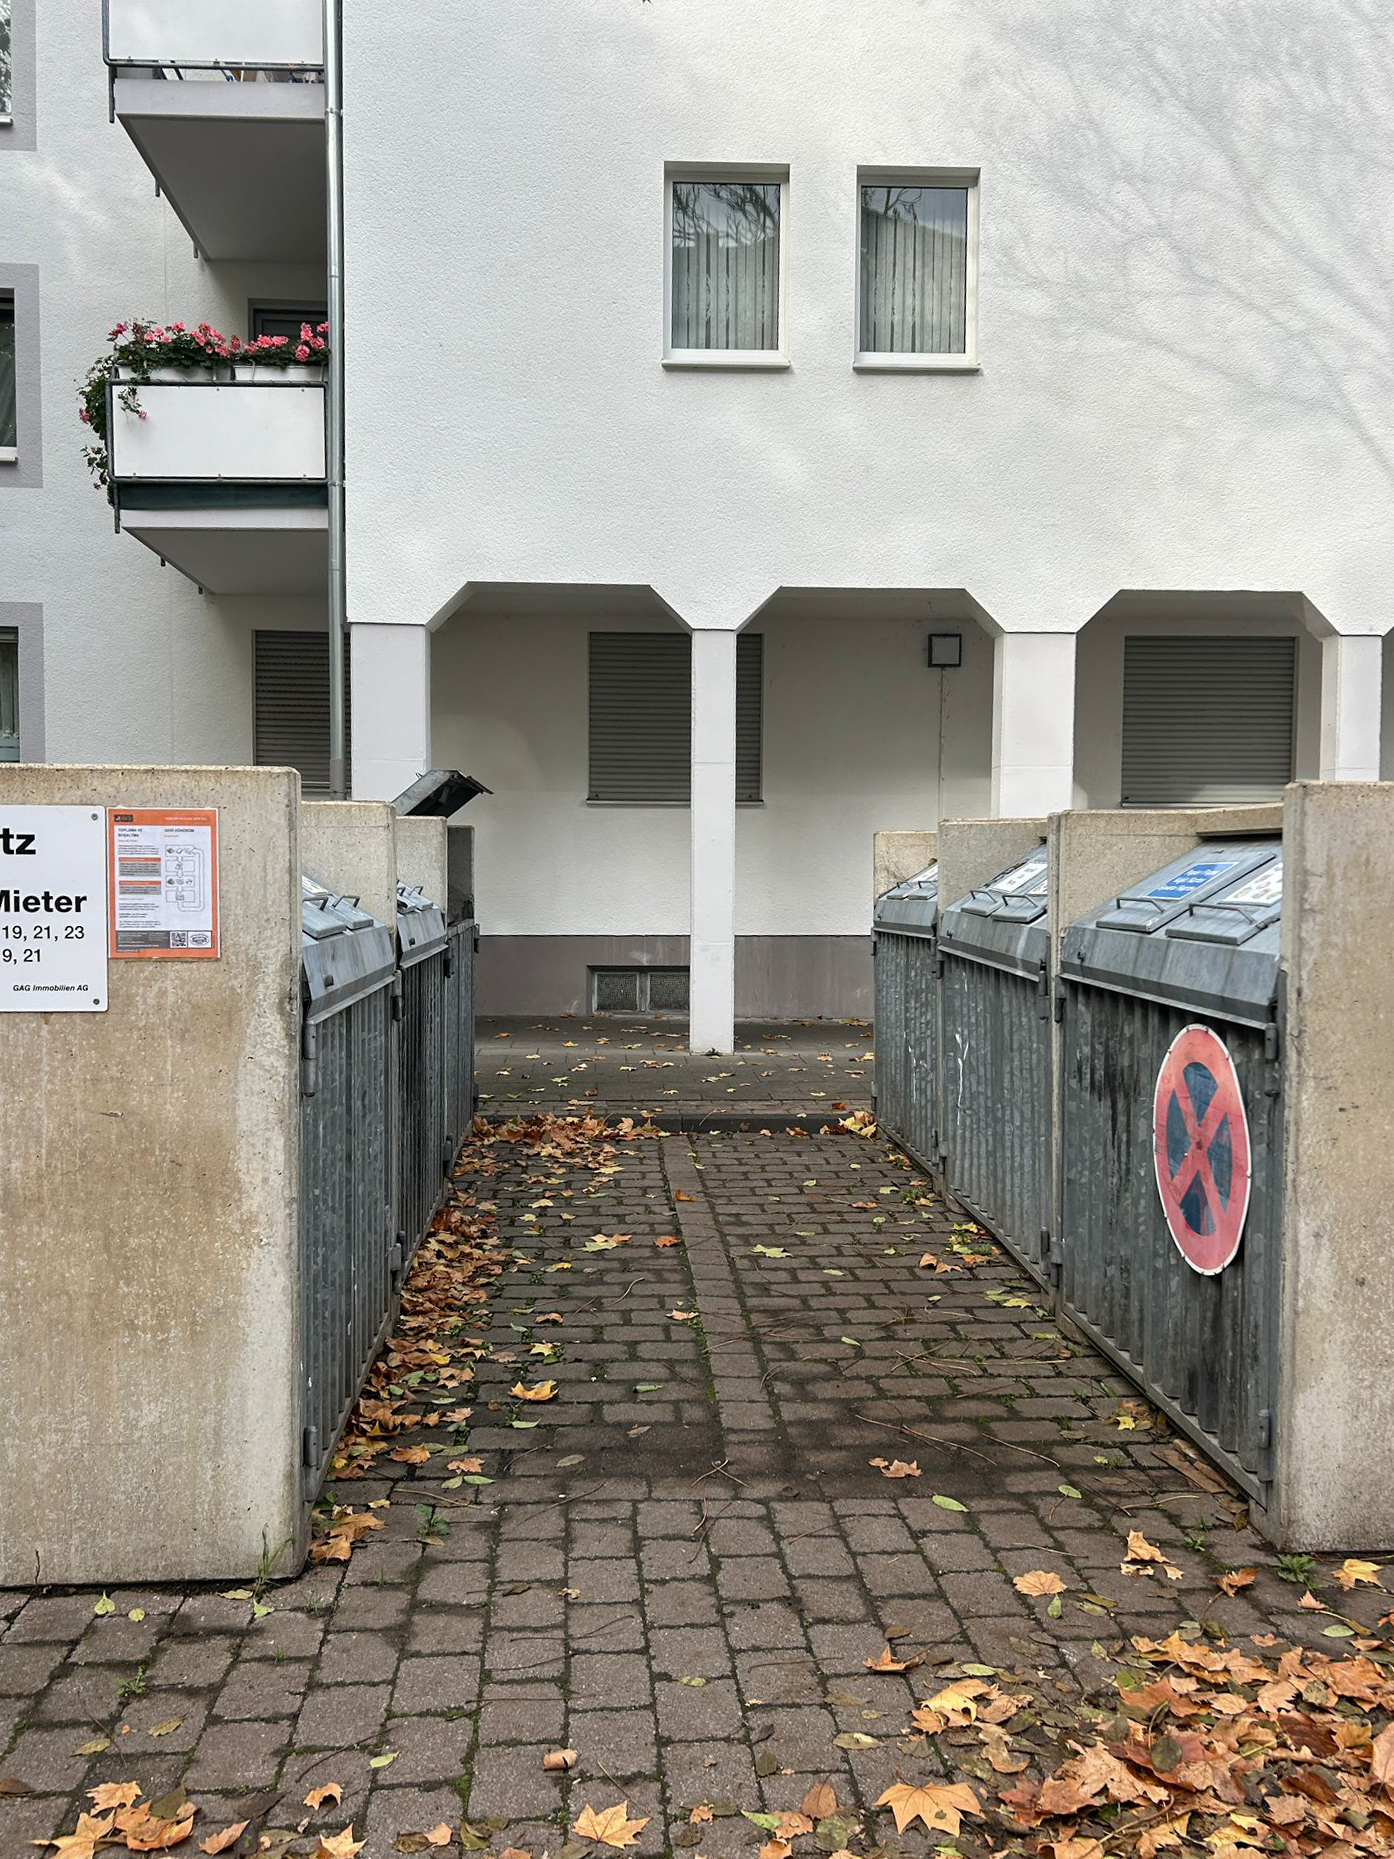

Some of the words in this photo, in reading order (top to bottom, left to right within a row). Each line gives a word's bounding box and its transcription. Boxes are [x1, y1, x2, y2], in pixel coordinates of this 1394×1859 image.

[2, 925, 27, 941] 19,
[34, 925, 59, 941] 21,
[65, 925, 85, 940] 23
[24, 948, 41, 962] 21
[12, 984, 31, 992] GAG
[32, 984, 75, 992] Immobilien
[76, 984, 89, 992] AG
